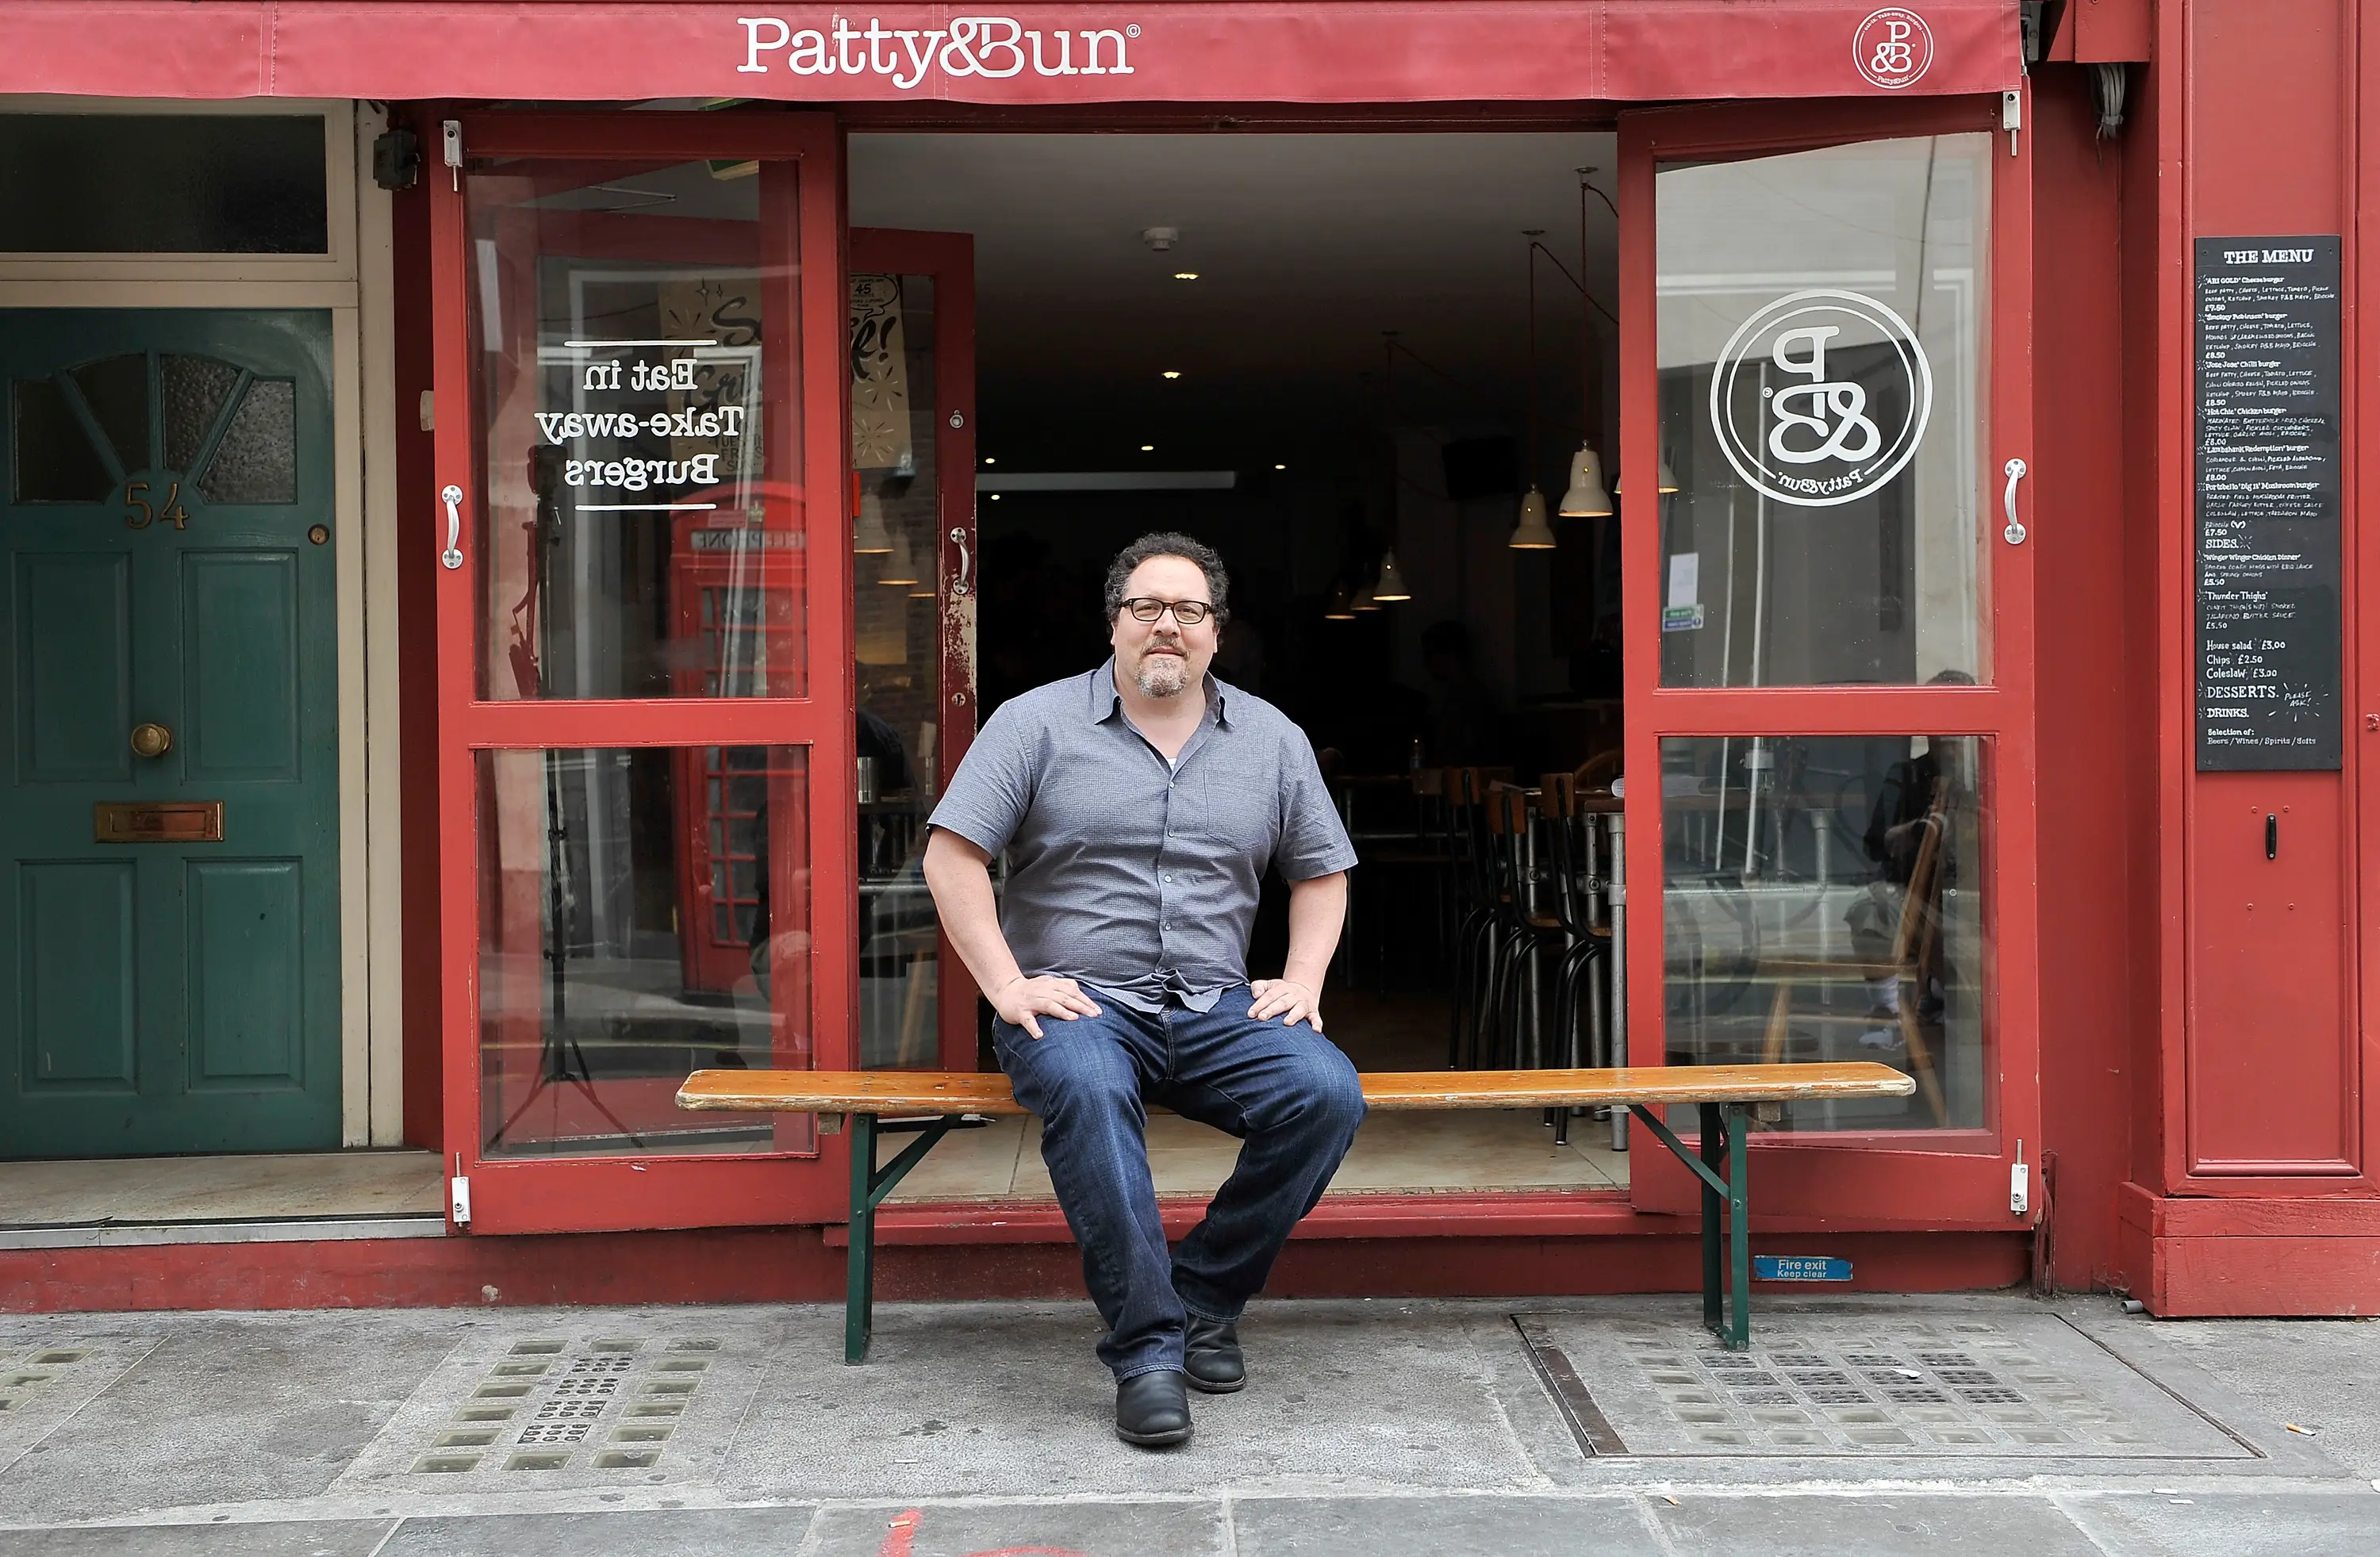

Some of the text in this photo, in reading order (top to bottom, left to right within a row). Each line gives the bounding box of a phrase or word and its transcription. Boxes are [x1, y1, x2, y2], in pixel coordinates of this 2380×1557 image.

[2224, 249, 2314, 264] THE MENU
[125, 482, 190, 530] 54
[2205, 539, 2239, 548] SIDES.
[2205, 592, 2268, 602] 'Thunder Thighs'
[2206, 640, 2286, 650] House salad £3.00
[2206, 654, 2263, 666] Chips £2.50
[2206, 668, 2277, 679] Coleslaw £3.00
[2207, 686, 2279, 698] DESSERTS.
[2284, 690, 2312, 701] PLEASE
[2290, 698, 2312, 707] ASK!
[2207, 708, 2249, 718] DRINKS.
[1778, 1260, 1827, 1270] Fire exit
[1777, 1270, 1801, 1279] Keep
